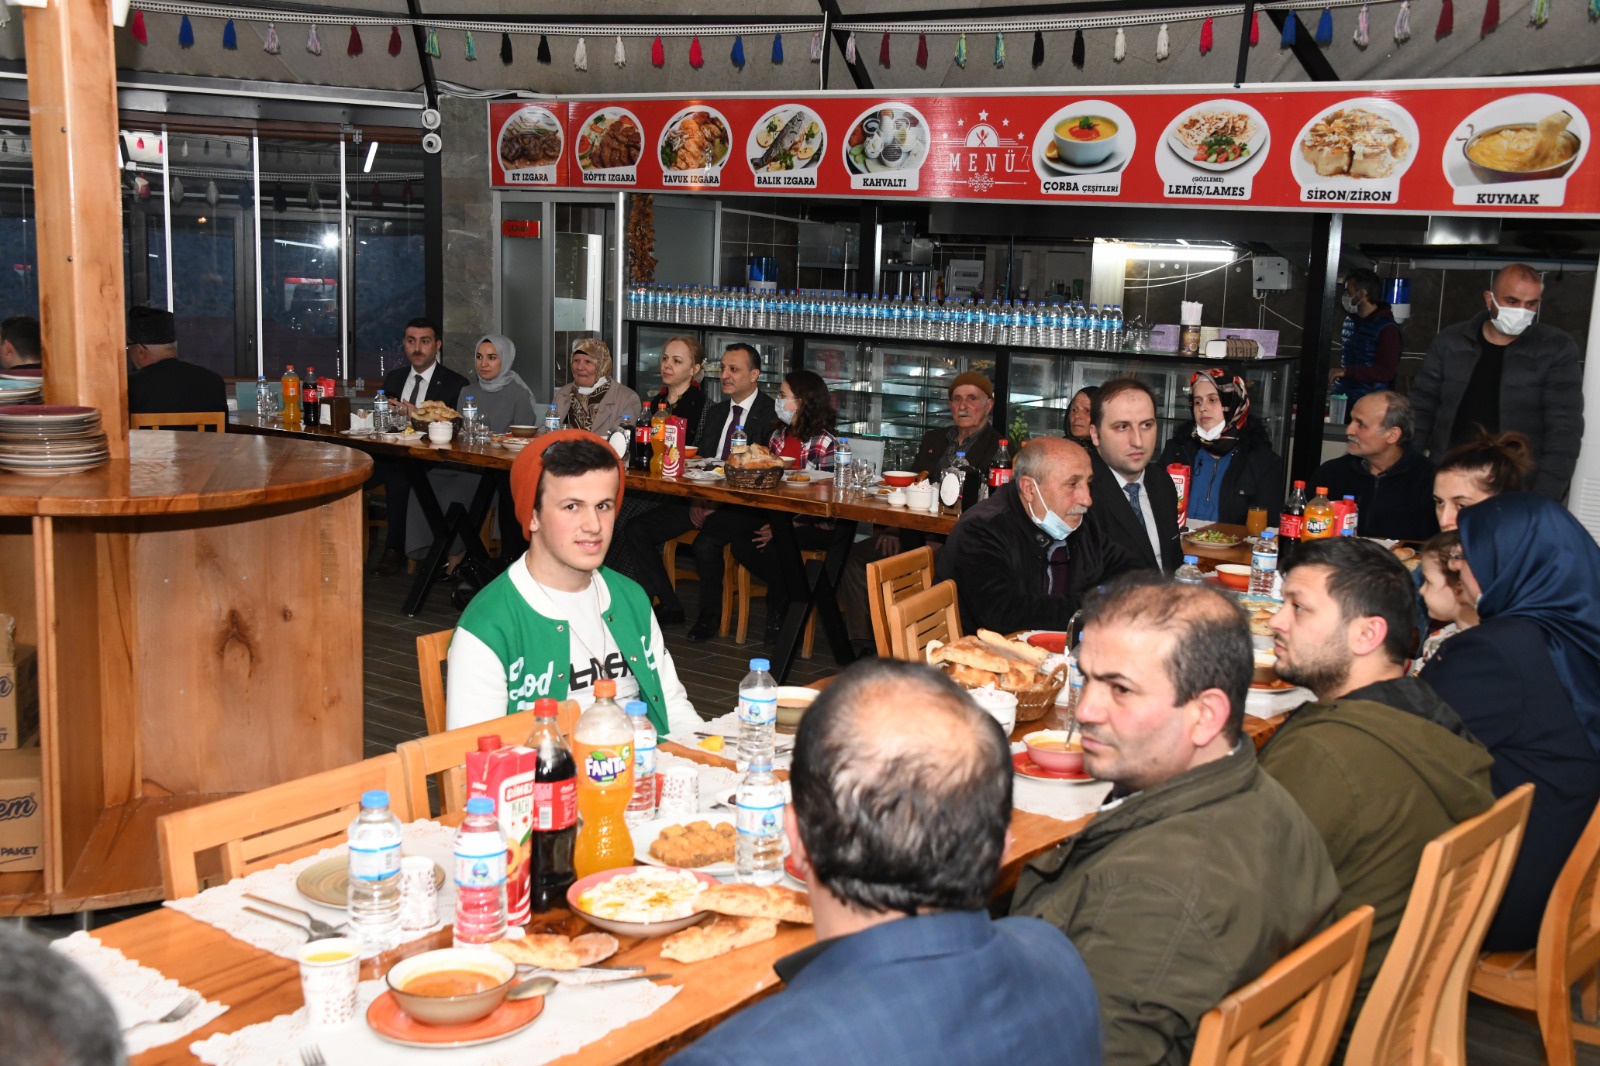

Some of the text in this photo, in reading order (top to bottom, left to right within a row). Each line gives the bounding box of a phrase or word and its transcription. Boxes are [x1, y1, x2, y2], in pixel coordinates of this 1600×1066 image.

[949, 149, 1016, 173] MENÜ
[511, 173, 549, 182] ET IZGARA
[583, 171, 636, 183] KÖFTE IZGARA
[663, 174, 720, 184] TAVUK IZGARA
[756, 176, 816, 186] BALIK IZGARA
[862, 178, 907, 188] KAHVALTI
[1043, 181, 1119, 194] ÇORBA ÇEŞİTLERİ
[1168, 182, 1245, 197] LEMİS/LAMES
[1306, 187, 1392, 202] SİRON/ZİRON
[1476, 193, 1540, 205] KUYMAK
[585, 757, 626, 776] FANTA
[1, 846, 39, 856] PAKET
